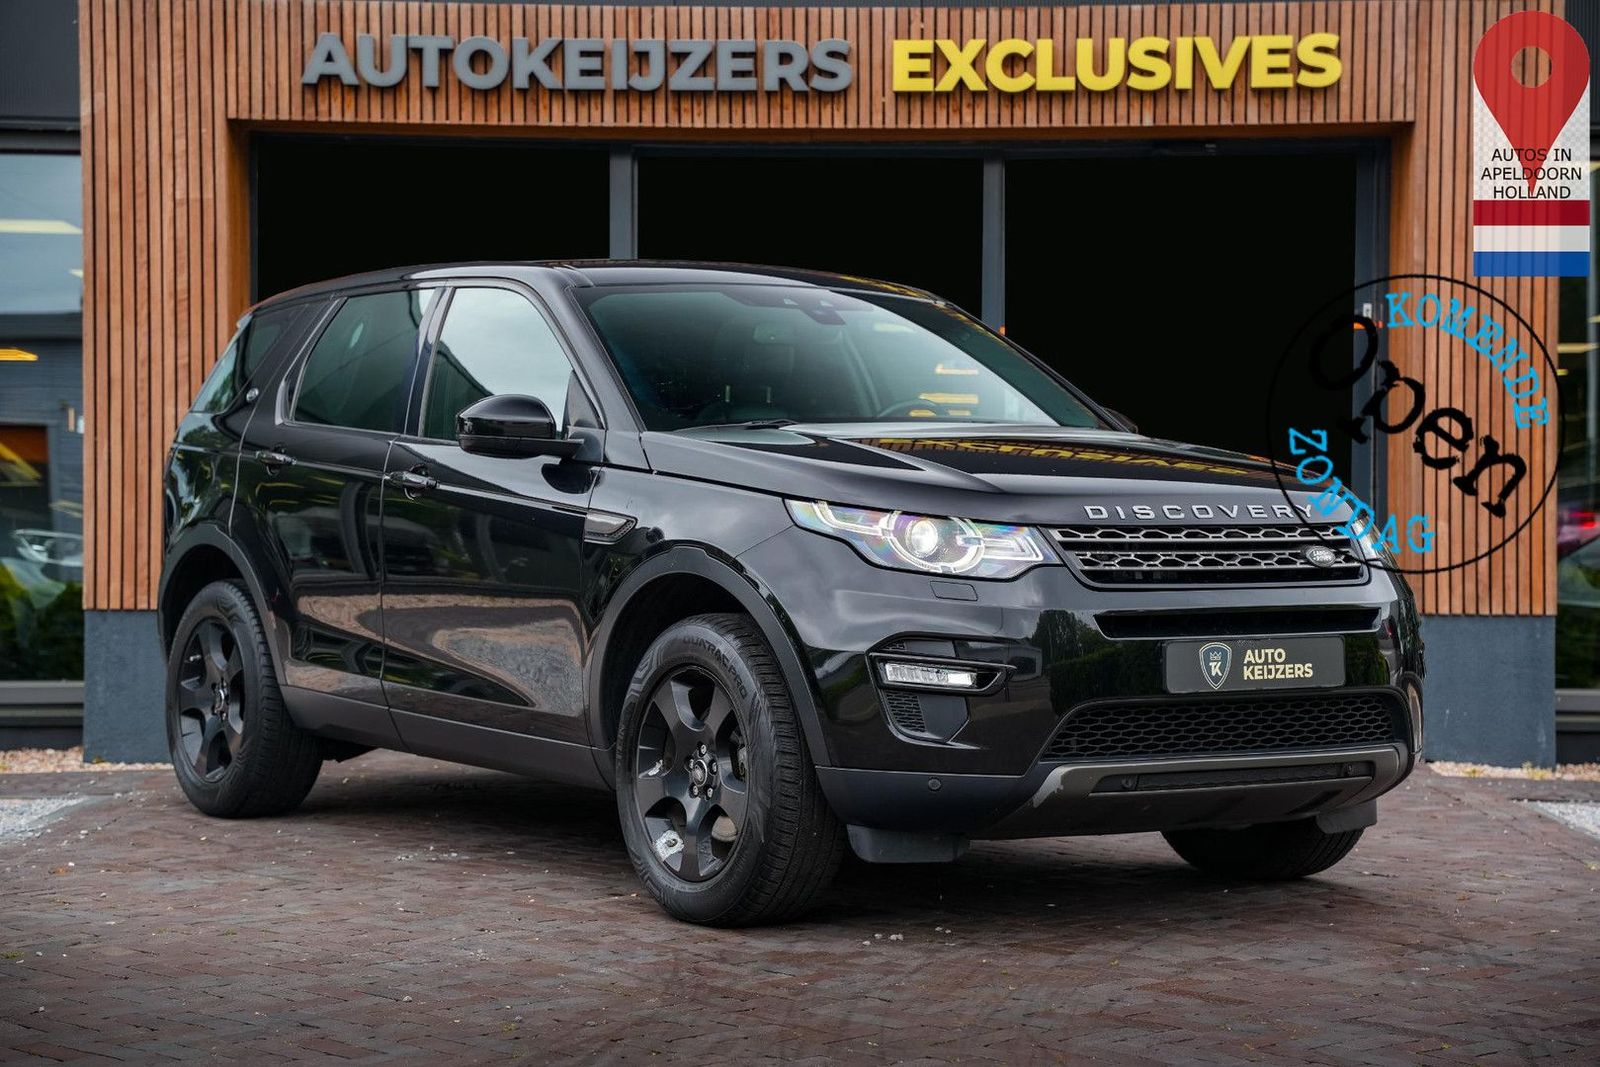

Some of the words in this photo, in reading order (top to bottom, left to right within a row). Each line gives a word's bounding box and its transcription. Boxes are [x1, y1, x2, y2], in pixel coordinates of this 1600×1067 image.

[300, 32, 853, 92] AUTOKEIJZERS
[892, 32, 1343, 93] EXCLUSIVES
[1083, 504, 1312, 520] DISCOVERY
[1243, 648, 1286, 664] AUTO
[1243, 663, 1314, 680] KEIJZERS
